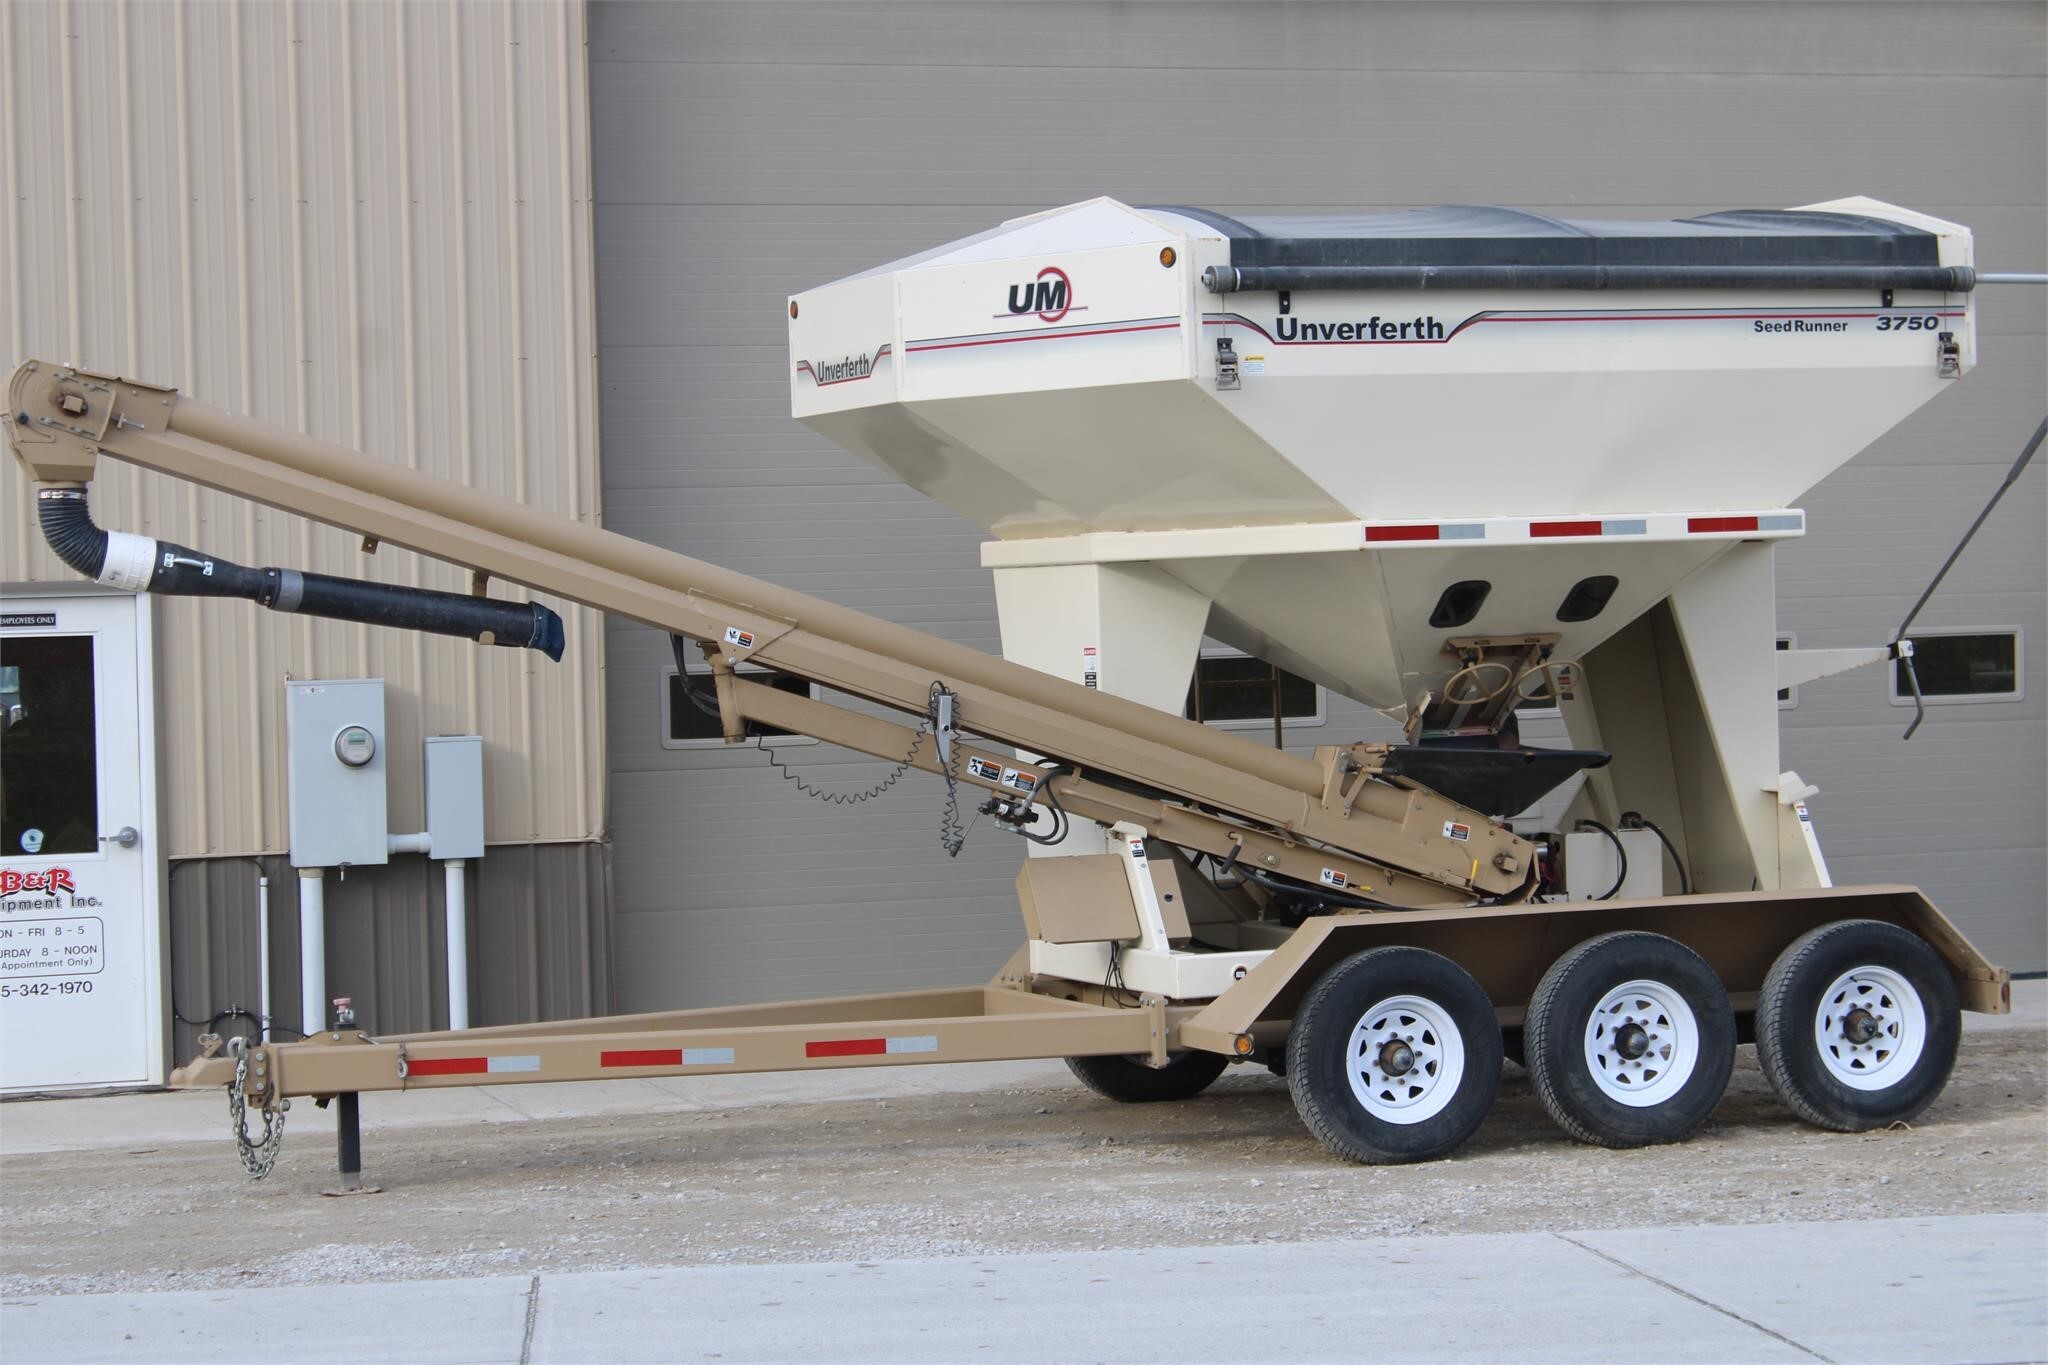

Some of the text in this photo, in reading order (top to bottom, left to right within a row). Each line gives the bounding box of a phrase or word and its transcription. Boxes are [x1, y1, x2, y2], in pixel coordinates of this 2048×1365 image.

[1008, 280, 1067, 314] UM
[1276, 316, 1444, 341] Unverferth
[1876, 317, 1940, 331] 3750
[817, 353, 870, 382] Unverferth
[36, 616, 55, 624] ONLY
[0, 867, 76, 898] B&R
[1, 896, 103, 912] ipment Inc.
[28, 927, 46, 937] FRI
[54, 926, 62, 936] 8
[78, 925, 85, 935] 5
[41, 947, 49, 957] 8
[64, 945, 98, 956] NOON
[1, 957, 93, 971] Appointment Only)
[1, 980, 94, 998] 5-342-1970
